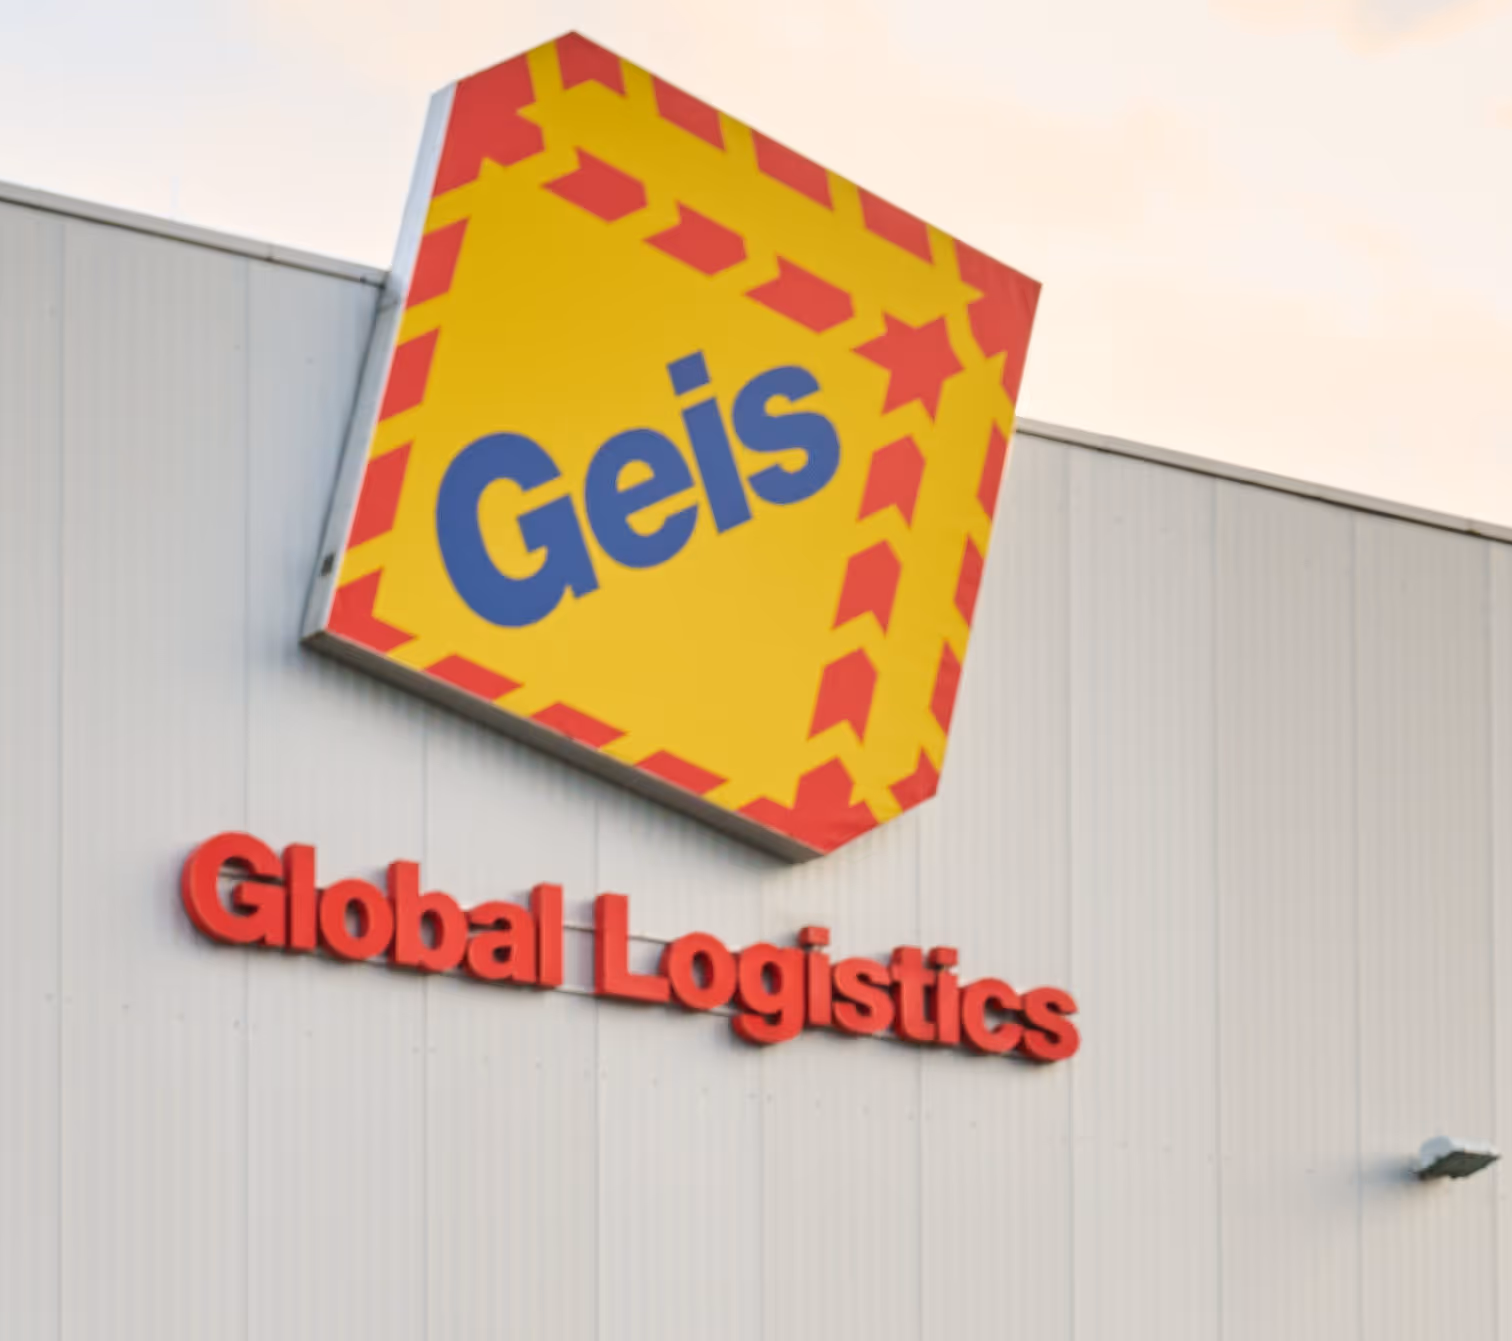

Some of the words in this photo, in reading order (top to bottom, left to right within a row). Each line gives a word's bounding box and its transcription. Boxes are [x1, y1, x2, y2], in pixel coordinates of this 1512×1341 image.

[434, 350, 841, 628] Geis
[181, 831, 564, 988] Global
[593, 892, 1081, 1062] Logistics
